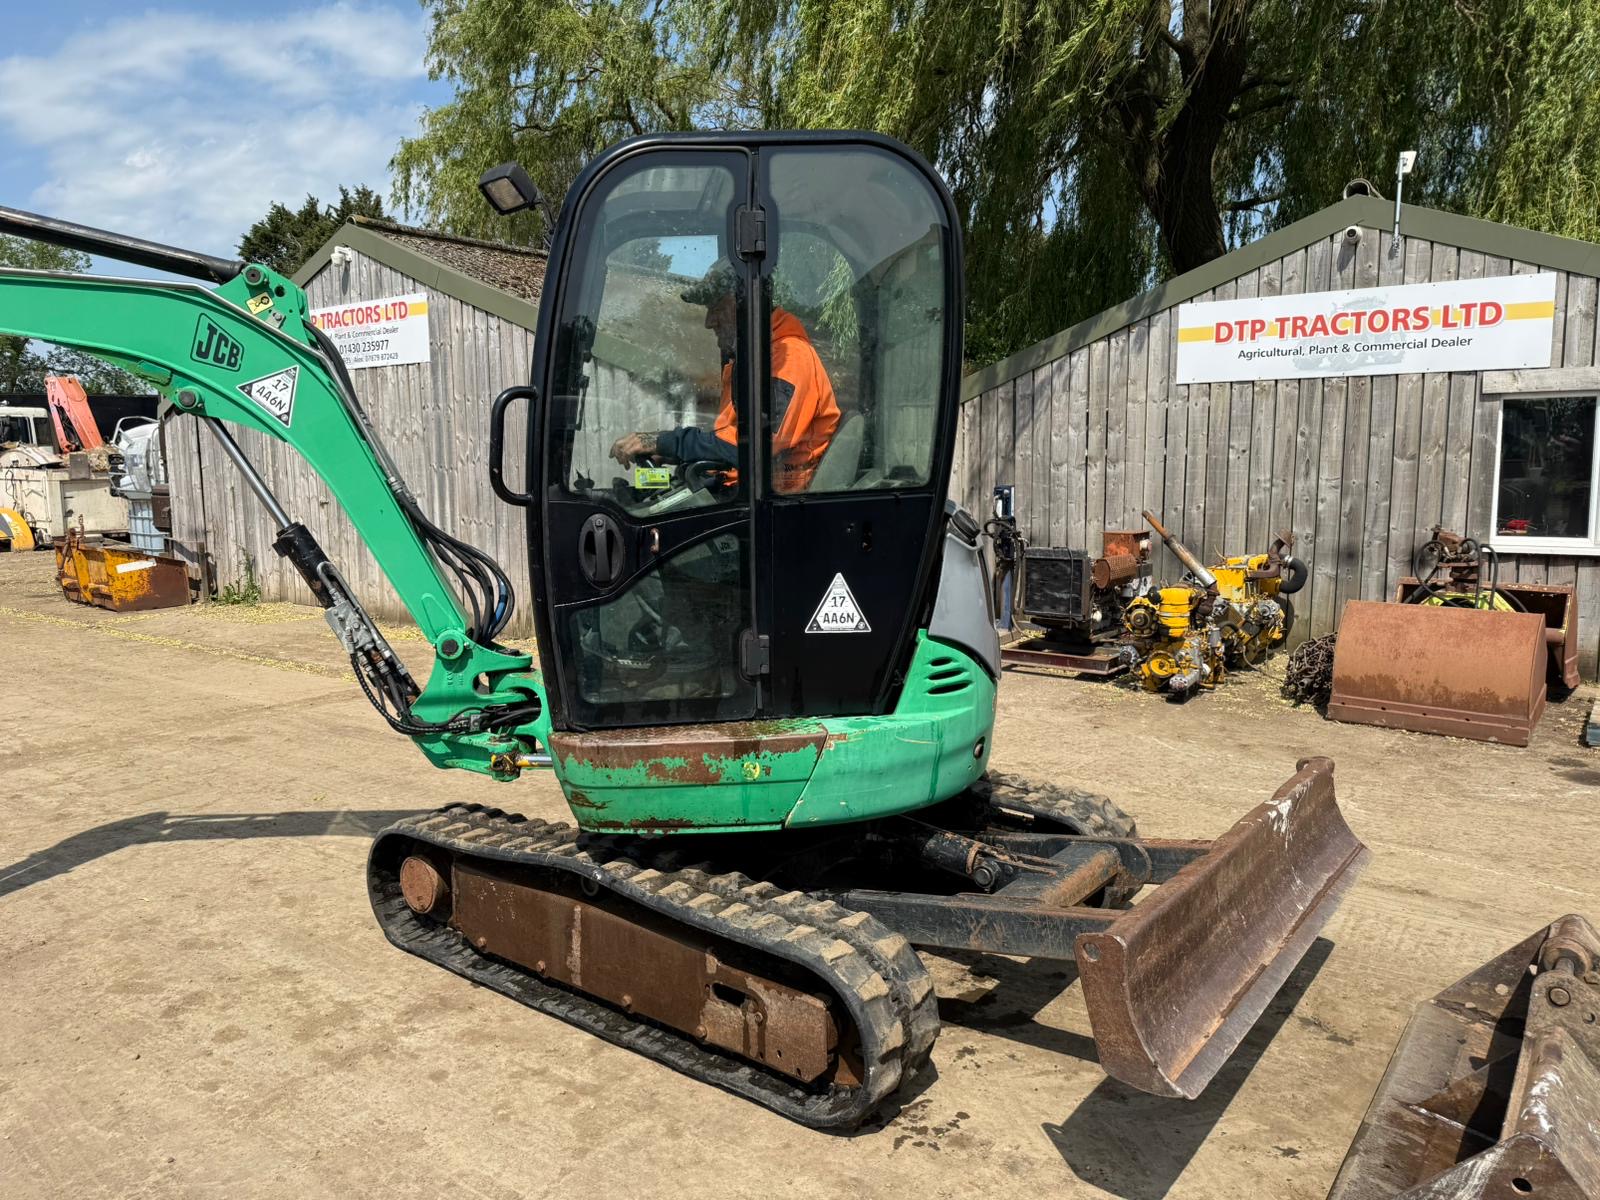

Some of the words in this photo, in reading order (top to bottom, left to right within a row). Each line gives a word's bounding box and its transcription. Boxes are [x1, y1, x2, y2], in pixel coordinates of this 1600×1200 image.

[320, 305, 380, 329] TRACTORS
[385, 301, 408, 320] LTD
[1215, 319, 1266, 343] DTP
[1275, 307, 1430, 339] TRACTORS
[1441, 302, 1503, 328] LTD
[196, 322, 241, 368] JCB
[339, 343, 360, 355] 01430
[362, 340, 389, 353] 235977
[1238, 346, 1305, 361] Agricultural,
[1309, 345, 1338, 355] Plant
[1341, 343, 1350, 352] &
[1354, 338, 1427, 352] Commercial
[1431, 336, 1473, 348] Dealer
[256, 385, 287, 411] AA6N
[271, 379, 289, 392] 17
[831, 596, 846, 607] 17
[823, 612, 855, 624] AA6N
